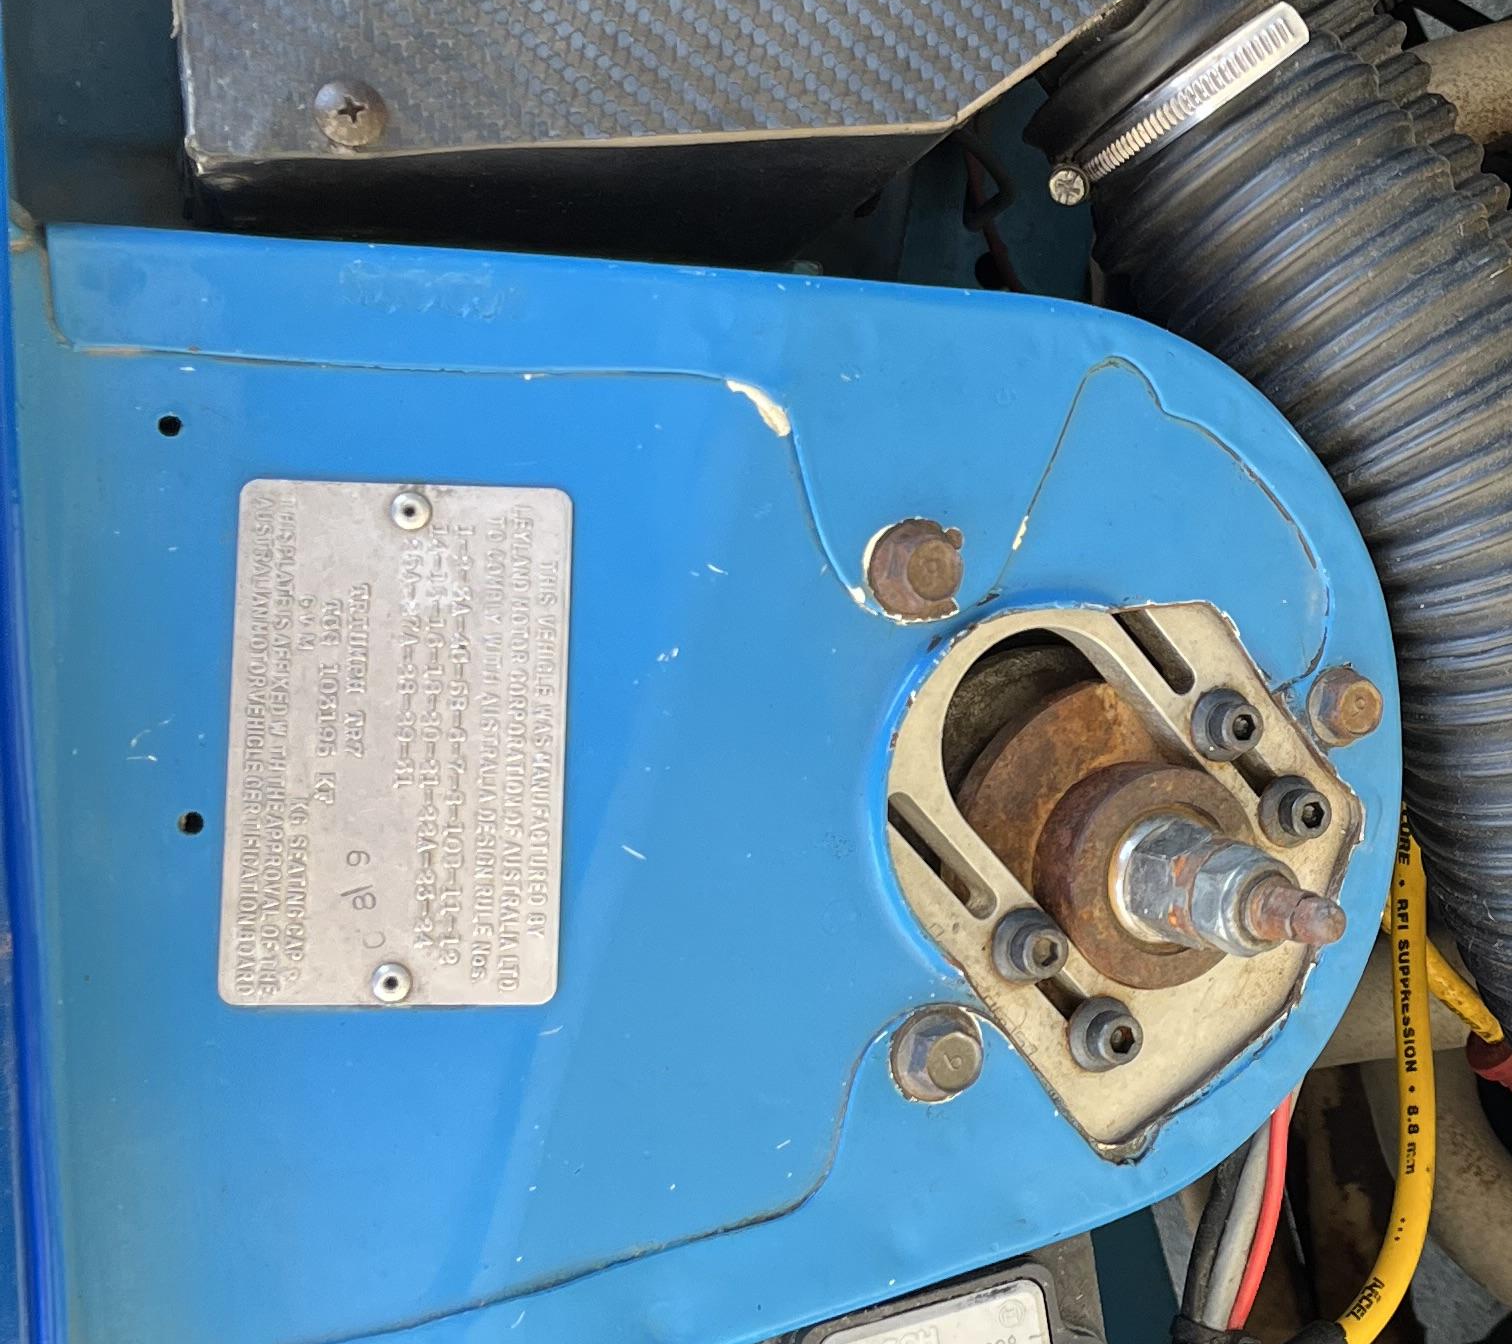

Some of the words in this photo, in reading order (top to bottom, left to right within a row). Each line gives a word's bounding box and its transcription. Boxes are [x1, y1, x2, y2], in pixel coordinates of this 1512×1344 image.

[276, 495, 297, 543] THIS
[487, 517, 506, 542] TO
[511, 505, 534, 591] LEYLAND
[249, 497, 273, 618] AUSTRALIAN
[274, 545, 295, 606] PLATE
[484, 548, 506, 624] COMPLY
[537, 561, 558, 607] THIS
[274, 609, 293, 630] IS
[346, 583, 372, 694] TRIUMPH
[510, 597, 531, 664] MOTOR
[247, 621, 270, 687] MOTOR
[270, 633, 291, 716] AFFIXED
[482, 632, 503, 684] WITH
[535, 614, 557, 696] VEHICLE
[243, 688, 267, 772] VEHICLE
[344, 710, 367, 759] TR7
[504, 669, 529, 806] CORPORATION
[533, 705, 553, 746] WAS
[266, 775, 287, 812] THE
[289, 797, 309, 825] KG
[503, 810, 522, 838] OF
[237, 775, 263, 925] CERTIFICATION
[474, 808, 495, 879] DESIGN
[528, 752, 552, 906] MANUFACTURED
[260, 815, 285, 922] APPROVAL
[285, 834, 308, 918] SEATING
[498, 841, 522, 950] AUSTRALIA
[261, 924, 279, 950] OF
[284, 923, 304, 961] CAP
[473, 885, 494, 937] RULE
[527, 913, 546, 940] BY
[235, 927, 257, 997] BOARD
[257, 955, 280, 997] THE
[1397, 898, 1409, 930] RFI
[1407, 1105, 1420, 1134] 8.8
